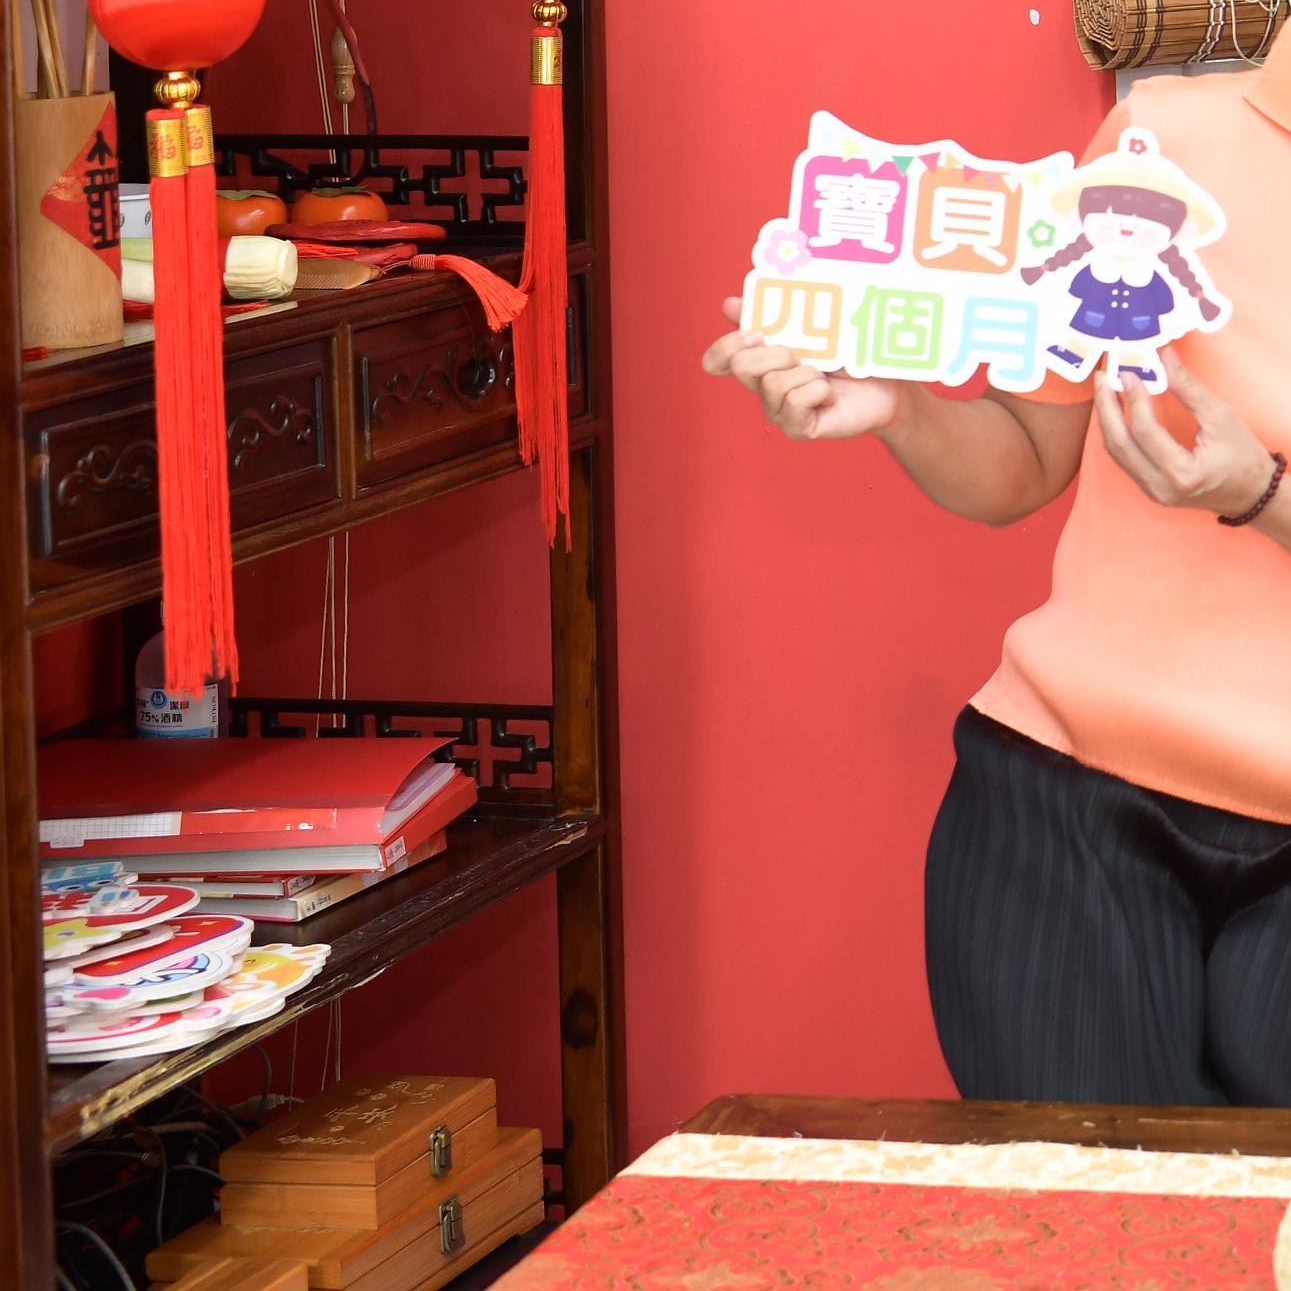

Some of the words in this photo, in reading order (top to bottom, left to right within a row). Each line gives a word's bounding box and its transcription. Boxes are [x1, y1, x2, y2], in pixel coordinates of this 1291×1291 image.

[808, 174, 1007, 264] 寶貝
[752, 278, 1039, 380] 四個月
